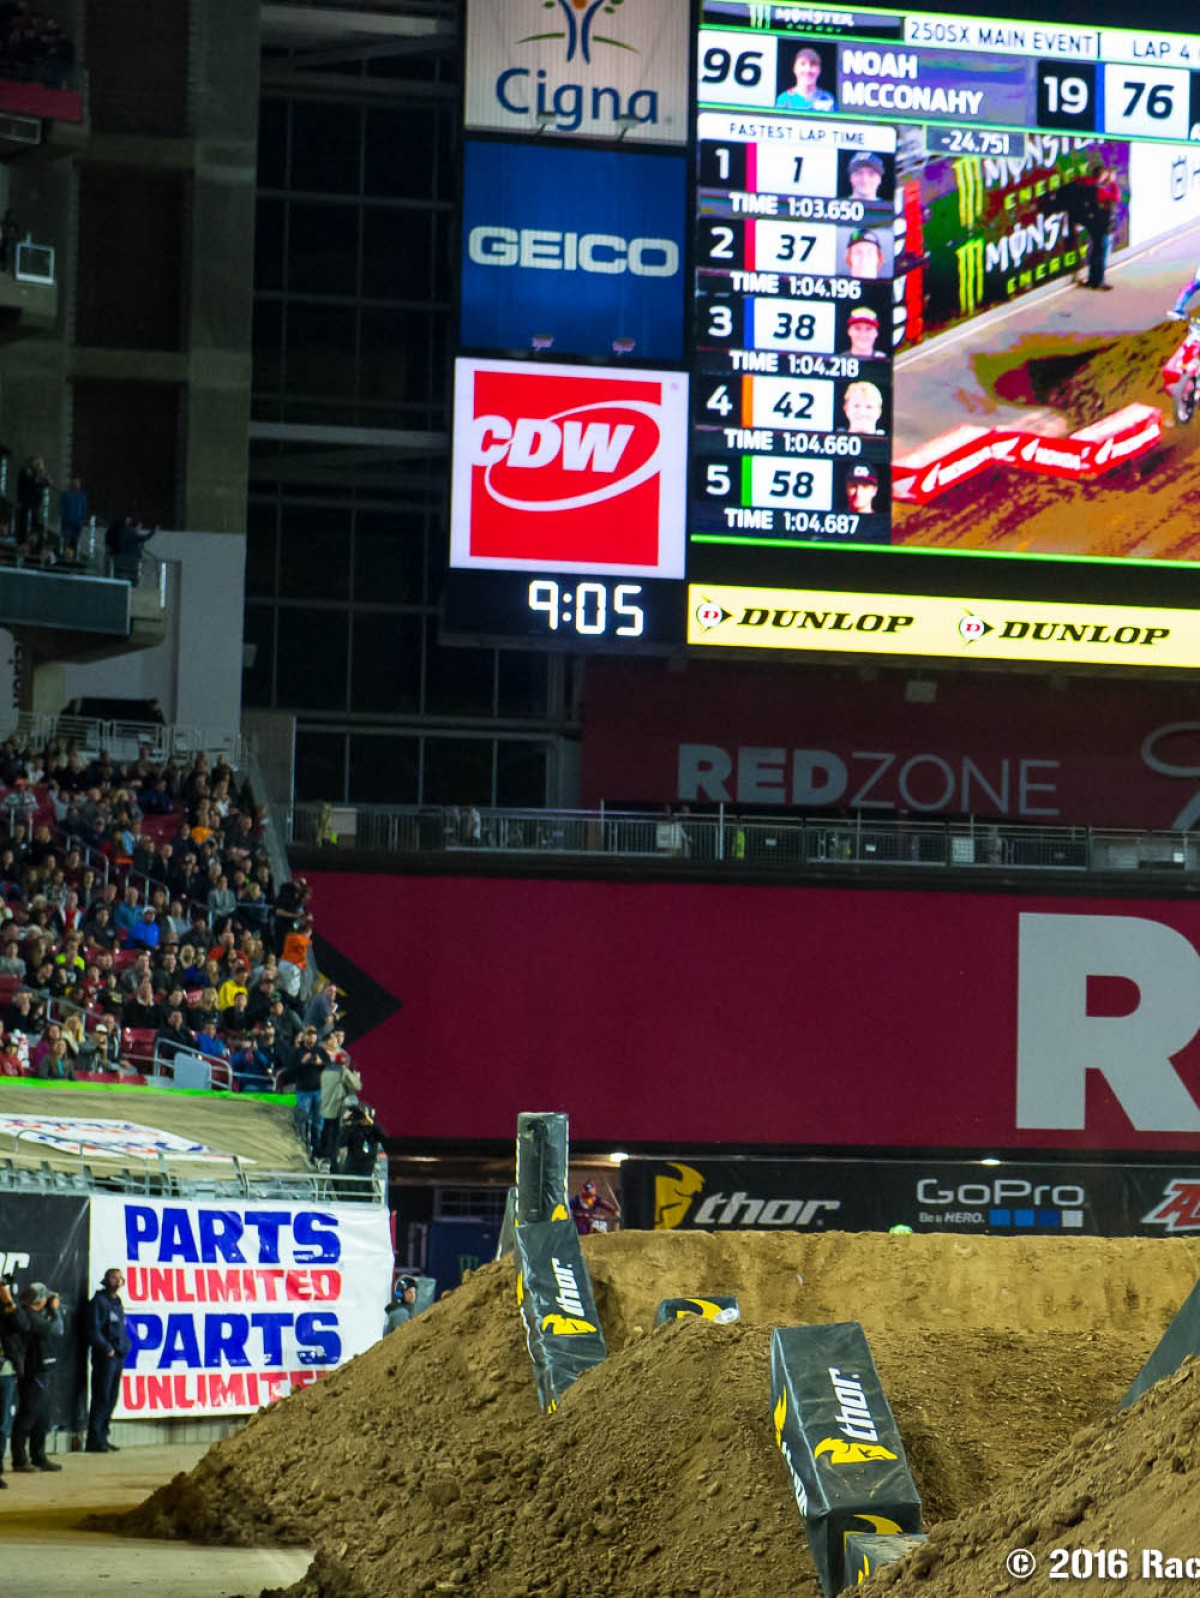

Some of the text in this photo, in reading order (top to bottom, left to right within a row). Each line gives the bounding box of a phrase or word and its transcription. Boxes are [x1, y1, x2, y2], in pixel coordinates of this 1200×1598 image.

[911, 20, 1094, 55] 250SX MAIN EVENT
[1132, 39, 1171, 59] LAP
[1179, 44, 1191, 62] 4
[702, 47, 763, 87] 96
[842, 50, 918, 79] NOAH
[495, 67, 659, 131] Cigna
[842, 82, 983, 115] MCCONAHY
[1043, 76, 1088, 114] 19
[1122, 81, 1174, 120] 76
[730, 123, 866, 145] FASTEST LAP TIME
[942, 130, 1010, 155] -24.751
[714, 148, 804, 184] 1 1
[729, 193, 864, 222] TIME 1:03.650
[468, 226, 680, 277] GEICO
[710, 227, 817, 263] 2 37
[730, 271, 861, 299] TIME 1:04.196
[708, 305, 816, 341] 3 38
[729, 350, 860, 377] TIME 1:04.218
[706, 385, 816, 420] 4 42
[472, 415, 635, 474] CDW
[724, 429, 862, 456] TIME 1:04.660
[706, 464, 815, 499] 5 58
[724, 508, 860, 535] TIME 1:04.687
[528, 580, 644, 637] 9:05
[737, 608, 914, 634] DUNLOP
[1000, 620, 1170, 645] DUNLOP
[678, 743, 1060, 816] REDZONE
[917, 1178, 1085, 1206] GoPro
[125, 1204, 342, 1264] PARTS
[126, 1267, 342, 1303] UNLIMITED
[125, 1312, 342, 1370] PARTS
[122, 1370, 327, 1410] UNLIMITE
